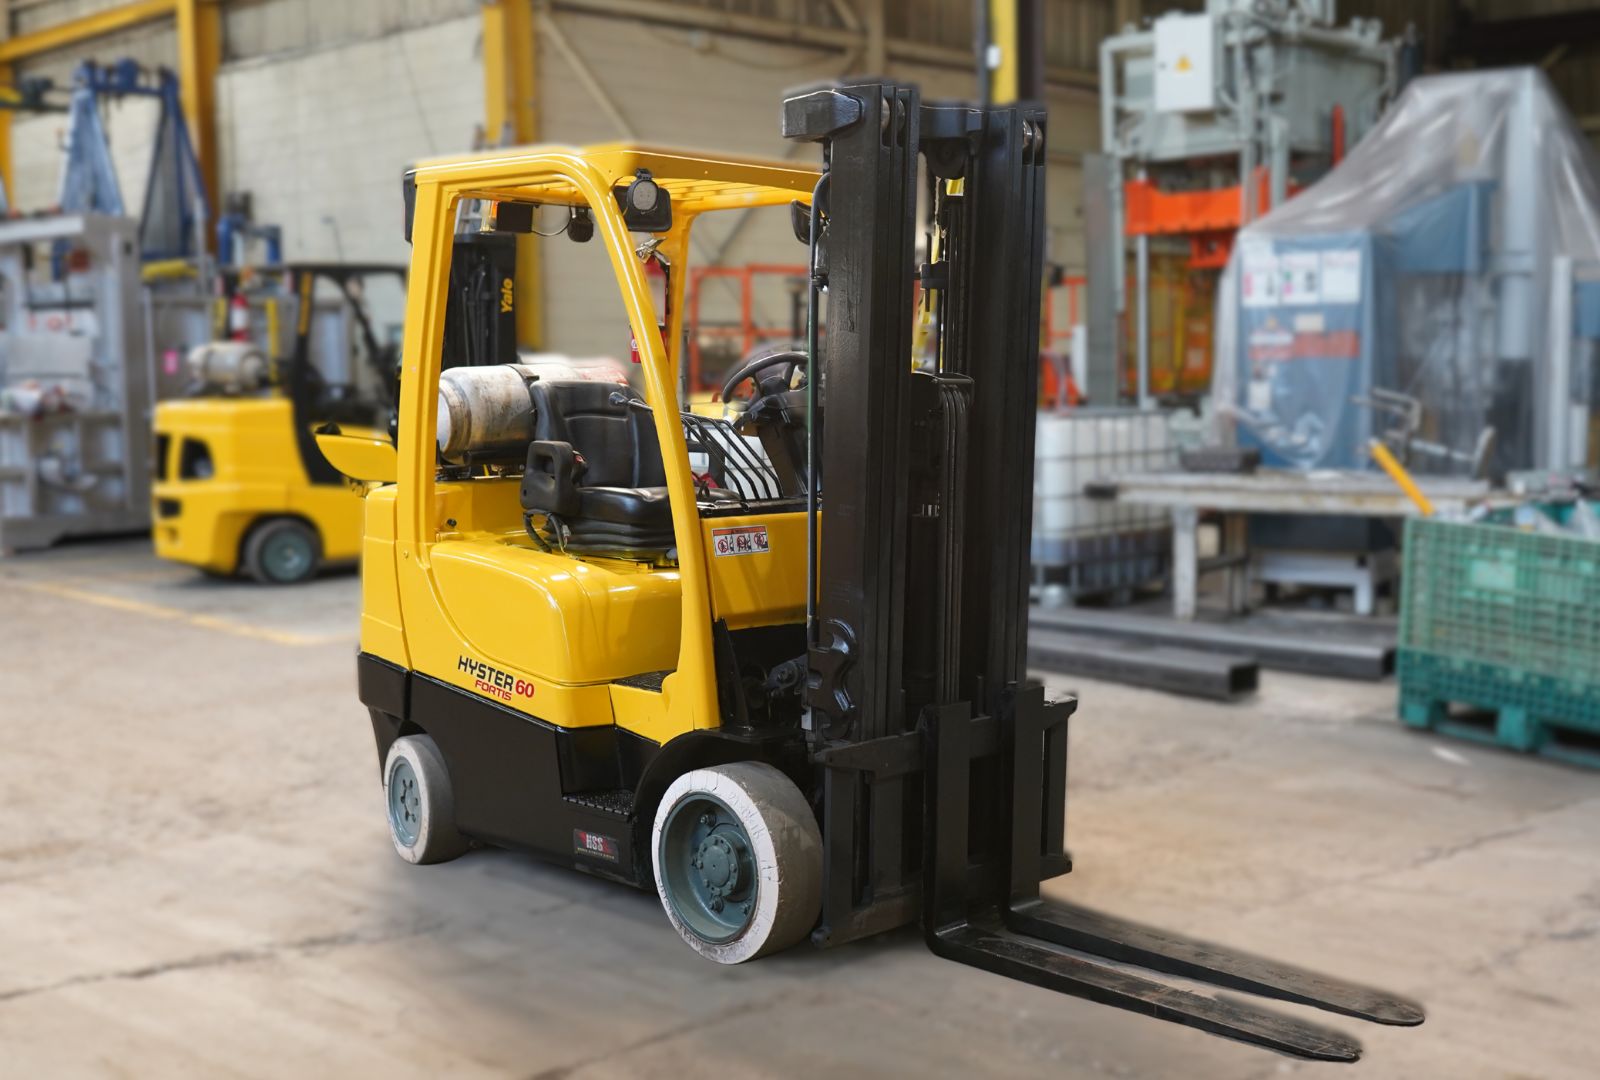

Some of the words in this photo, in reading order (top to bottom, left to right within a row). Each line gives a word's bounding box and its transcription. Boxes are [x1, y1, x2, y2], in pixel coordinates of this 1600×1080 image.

[458, 655, 514, 691] HYSTER
[515, 679, 535, 698] 60
[475, 679, 512, 701] FORTIS
[586, 833, 604, 851] HSS
